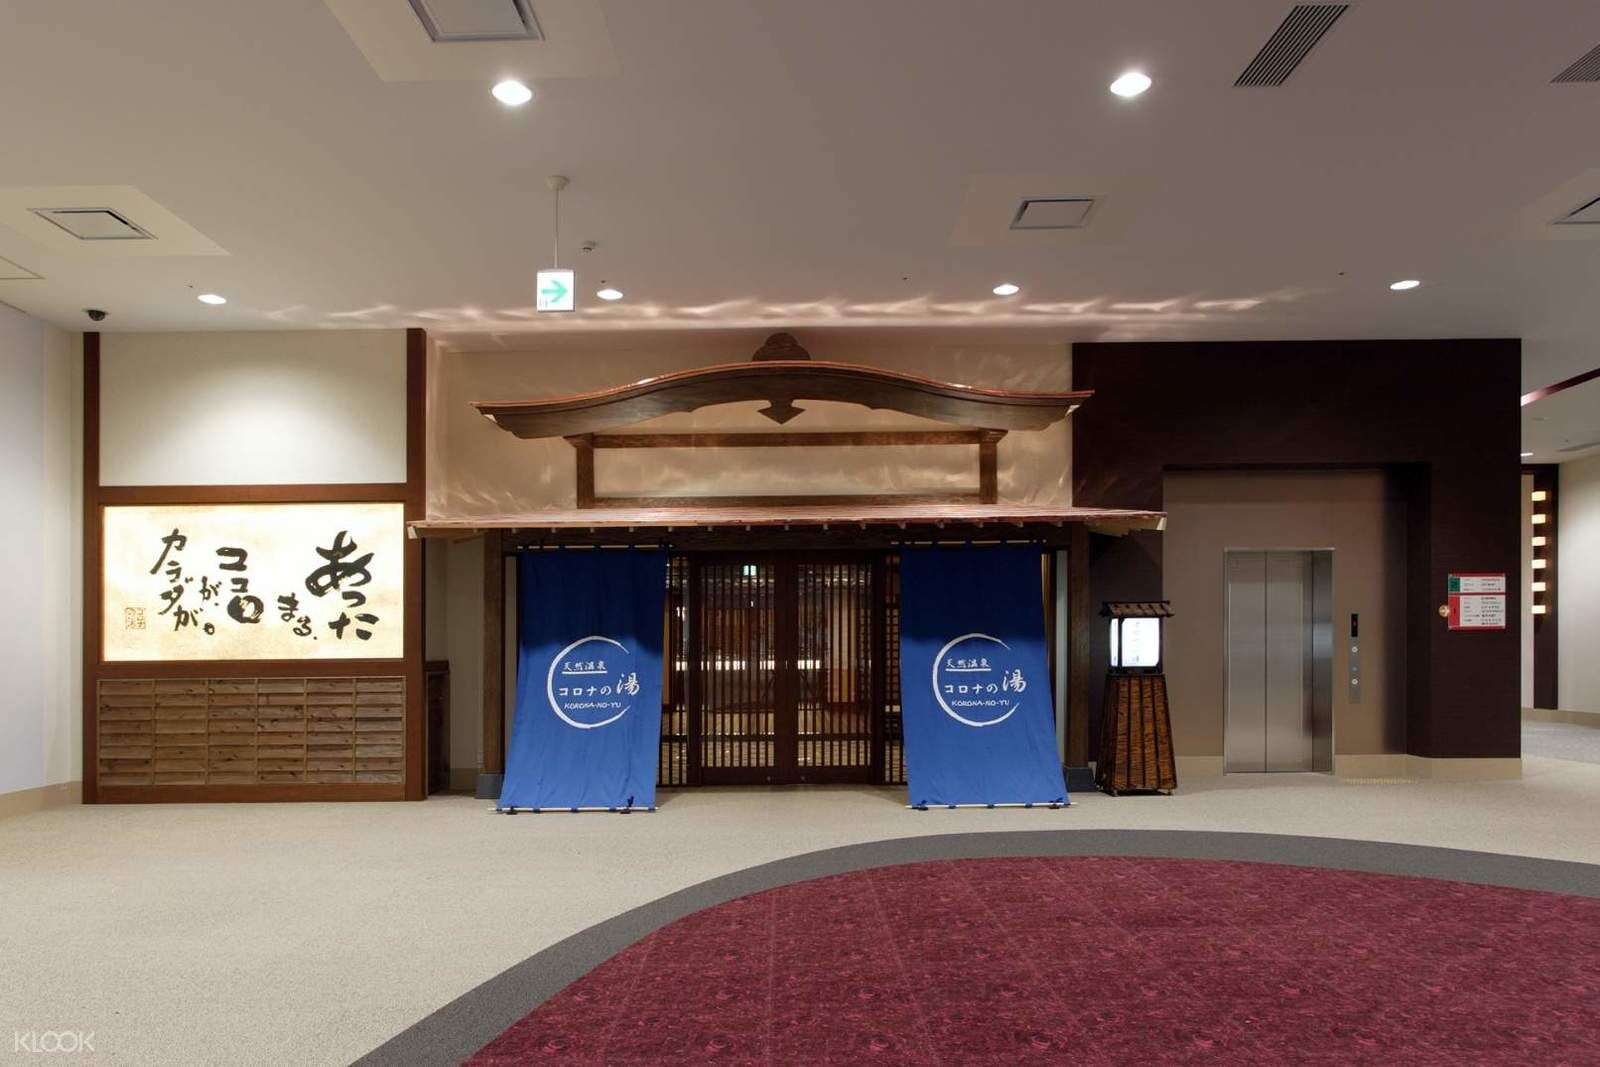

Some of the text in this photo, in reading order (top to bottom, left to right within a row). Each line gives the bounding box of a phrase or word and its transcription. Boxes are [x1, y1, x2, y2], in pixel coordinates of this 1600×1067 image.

[563, 660, 607, 672] 天然温泉
[946, 658, 990, 668] 天然温泉
